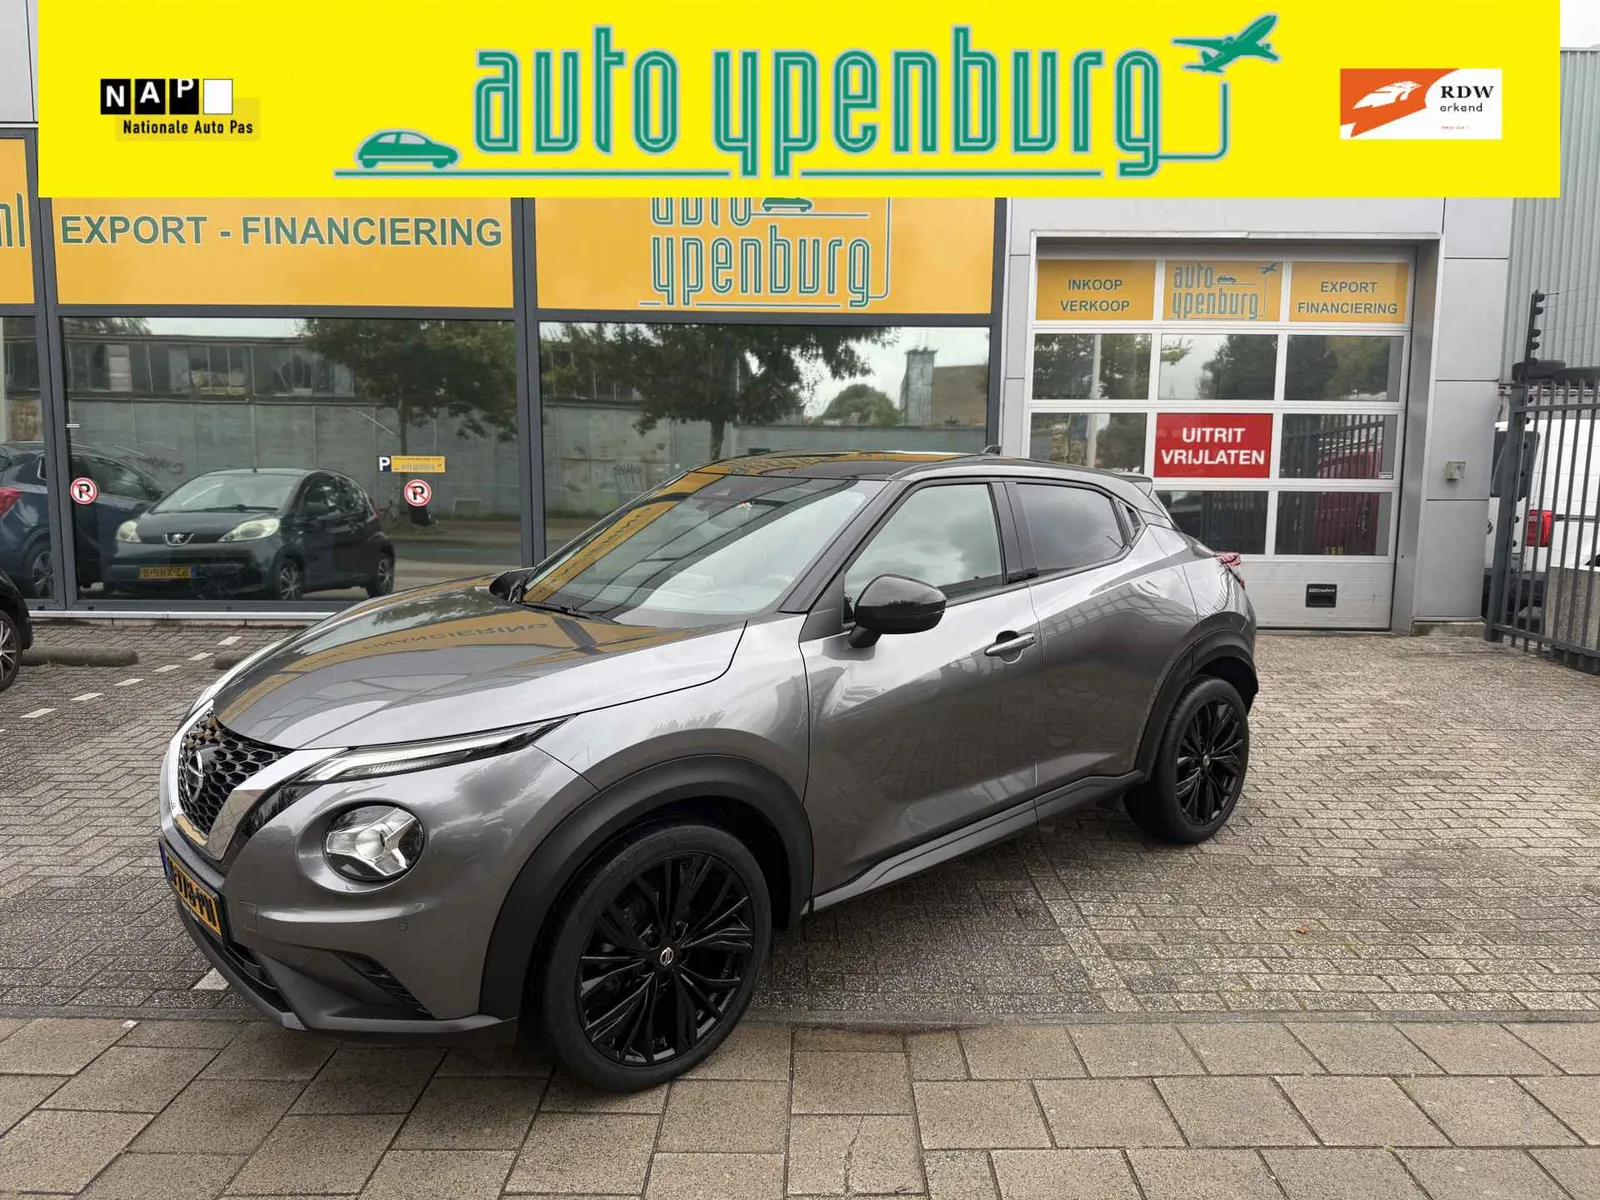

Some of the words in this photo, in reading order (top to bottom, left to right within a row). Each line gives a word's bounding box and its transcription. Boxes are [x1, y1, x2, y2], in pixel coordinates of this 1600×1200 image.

[60, 214, 208, 245] EXPORT
[241, 215, 502, 247] FINANCIERING
[652, 224, 870, 308] ypenburg
[1173, 264, 1214, 289] auto
[1067, 279, 1124, 291] INKOOP
[1320, 281, 1378, 293] EXPORT
[1060, 300, 1130, 312] VERKOOP
[1171, 288, 1259, 320] ypenburg
[1297, 302, 1398, 315] FINANCIERING
[1181, 427, 1246, 443] UITRIT
[1160, 449, 1266, 465] VRIJLATEN
